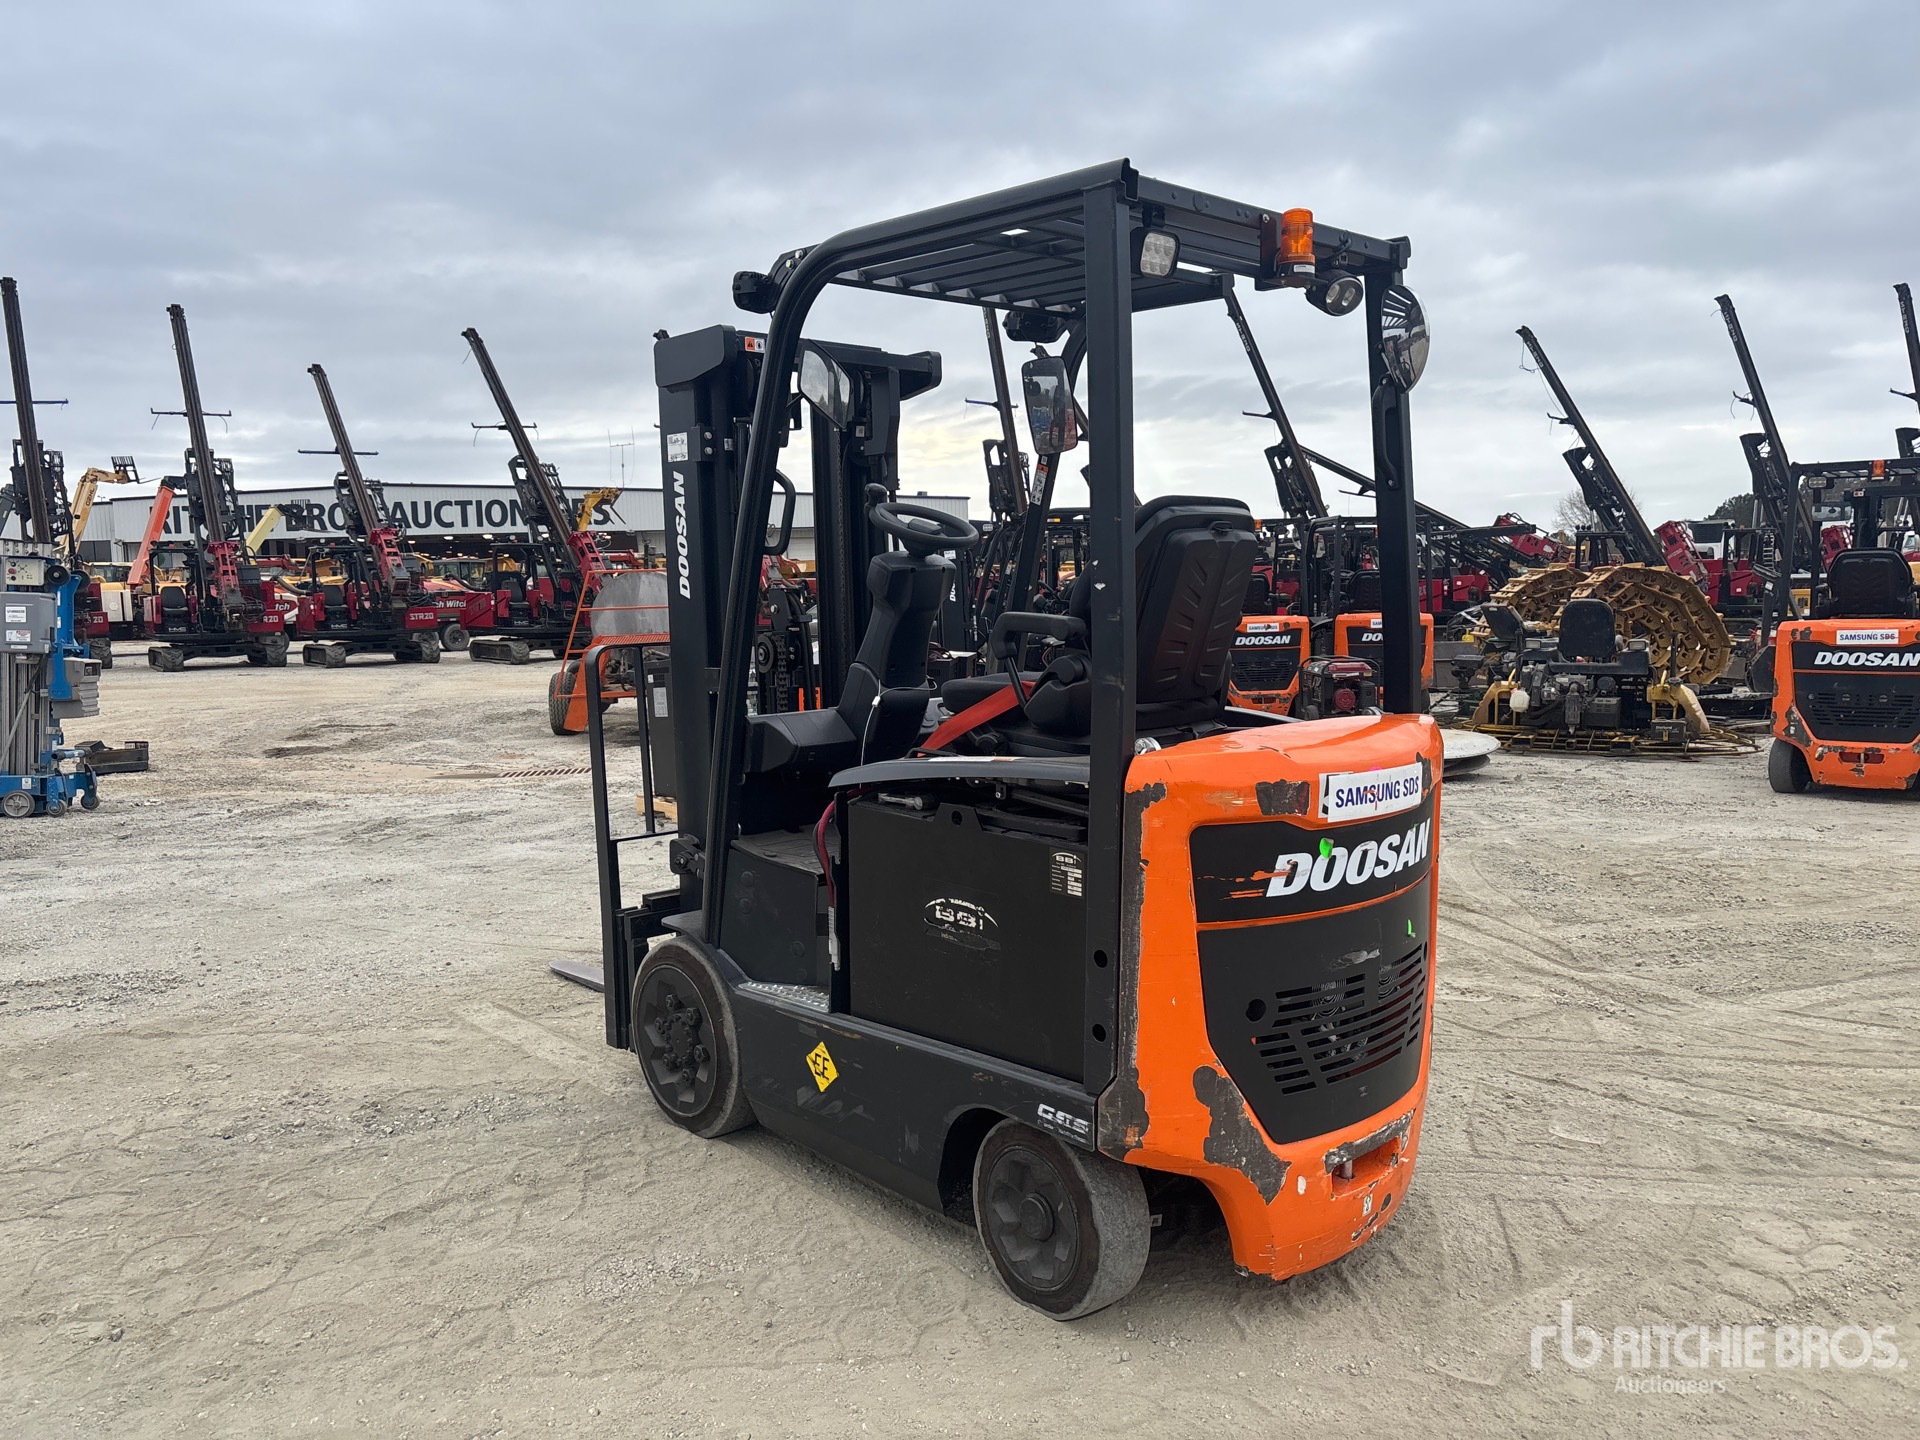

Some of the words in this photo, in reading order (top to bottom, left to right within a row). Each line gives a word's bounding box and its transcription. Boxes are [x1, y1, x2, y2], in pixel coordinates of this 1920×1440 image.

[672, 470, 691, 599] DOOSAN
[409, 612, 434, 621] STR20
[1235, 635, 1291, 646] DOOSAN
[1839, 633, 1878, 641] SAMSUNG
[1814, 651, 1920, 667] DOOSAN
[1335, 779, 1401, 809] SAMSUNG
[1402, 776, 1420, 798] SDS
[1266, 818, 1431, 898] DOOSAN
